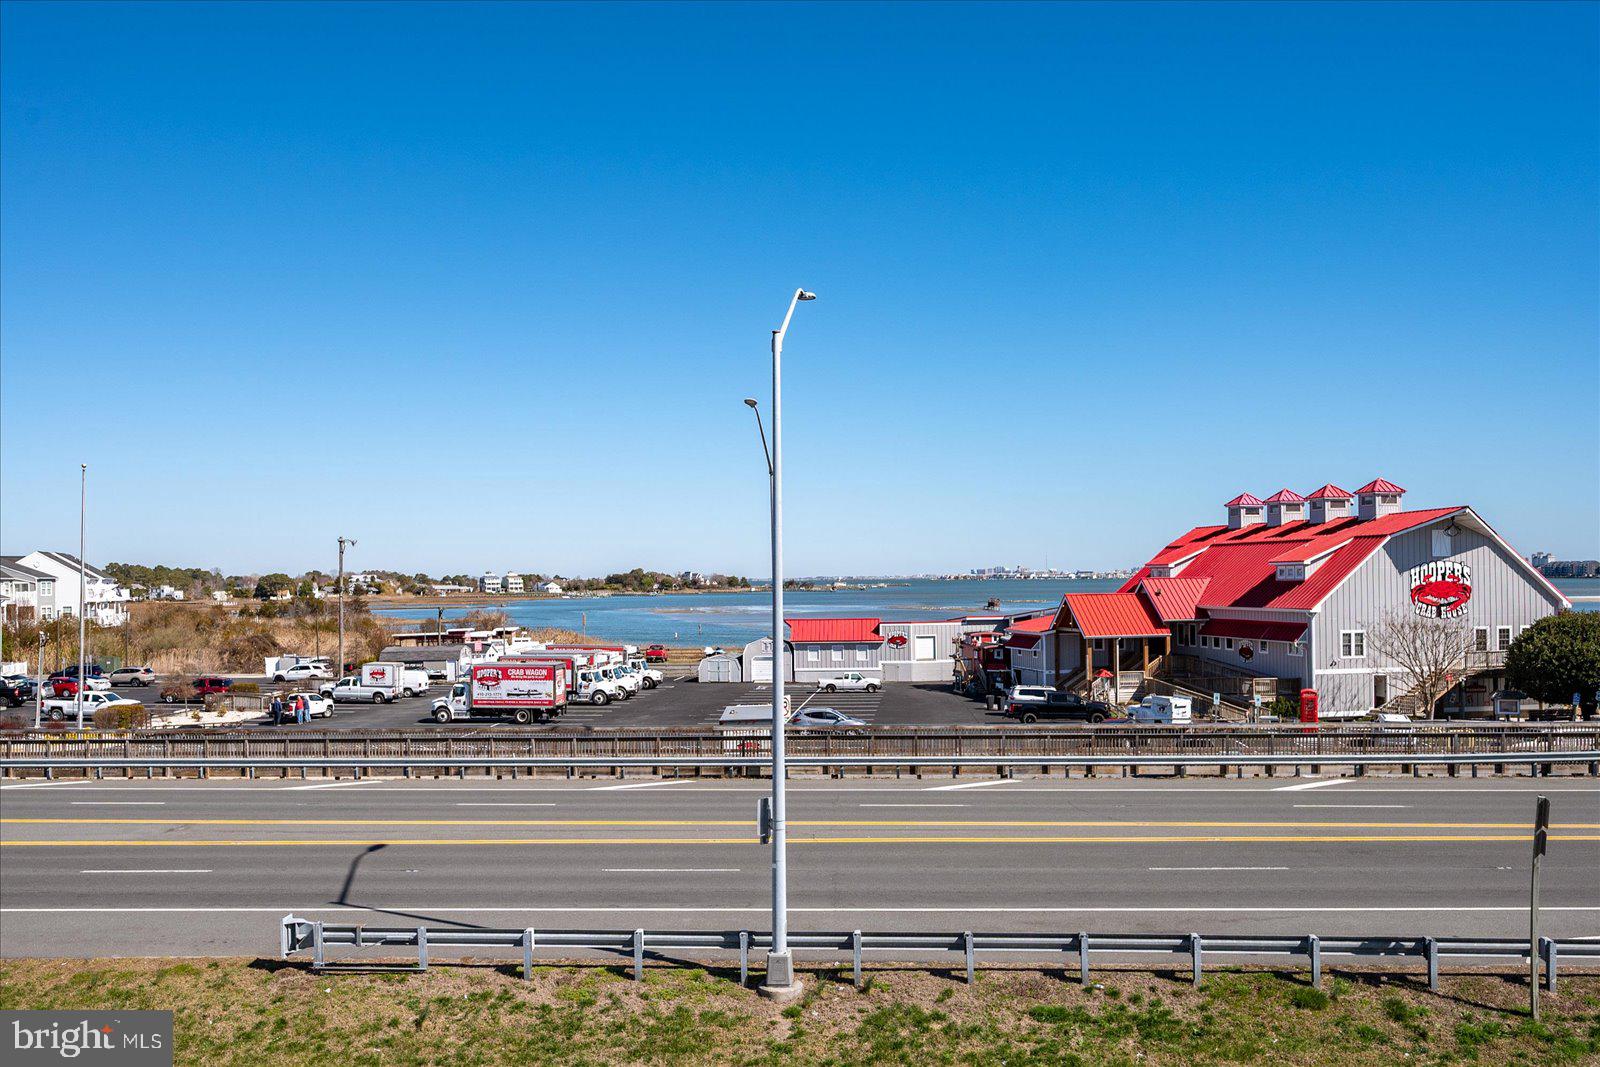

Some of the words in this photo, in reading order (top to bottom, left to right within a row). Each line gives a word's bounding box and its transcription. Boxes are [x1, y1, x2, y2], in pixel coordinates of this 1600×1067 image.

[1410, 560, 1472, 588] HOOPER'S
[1415, 603, 1437, 619] CRAB
[1441, 603, 1469, 619] HOUSE
[507, 668, 524, 676] CRAB
[525, 668, 548, 676] WAGON
